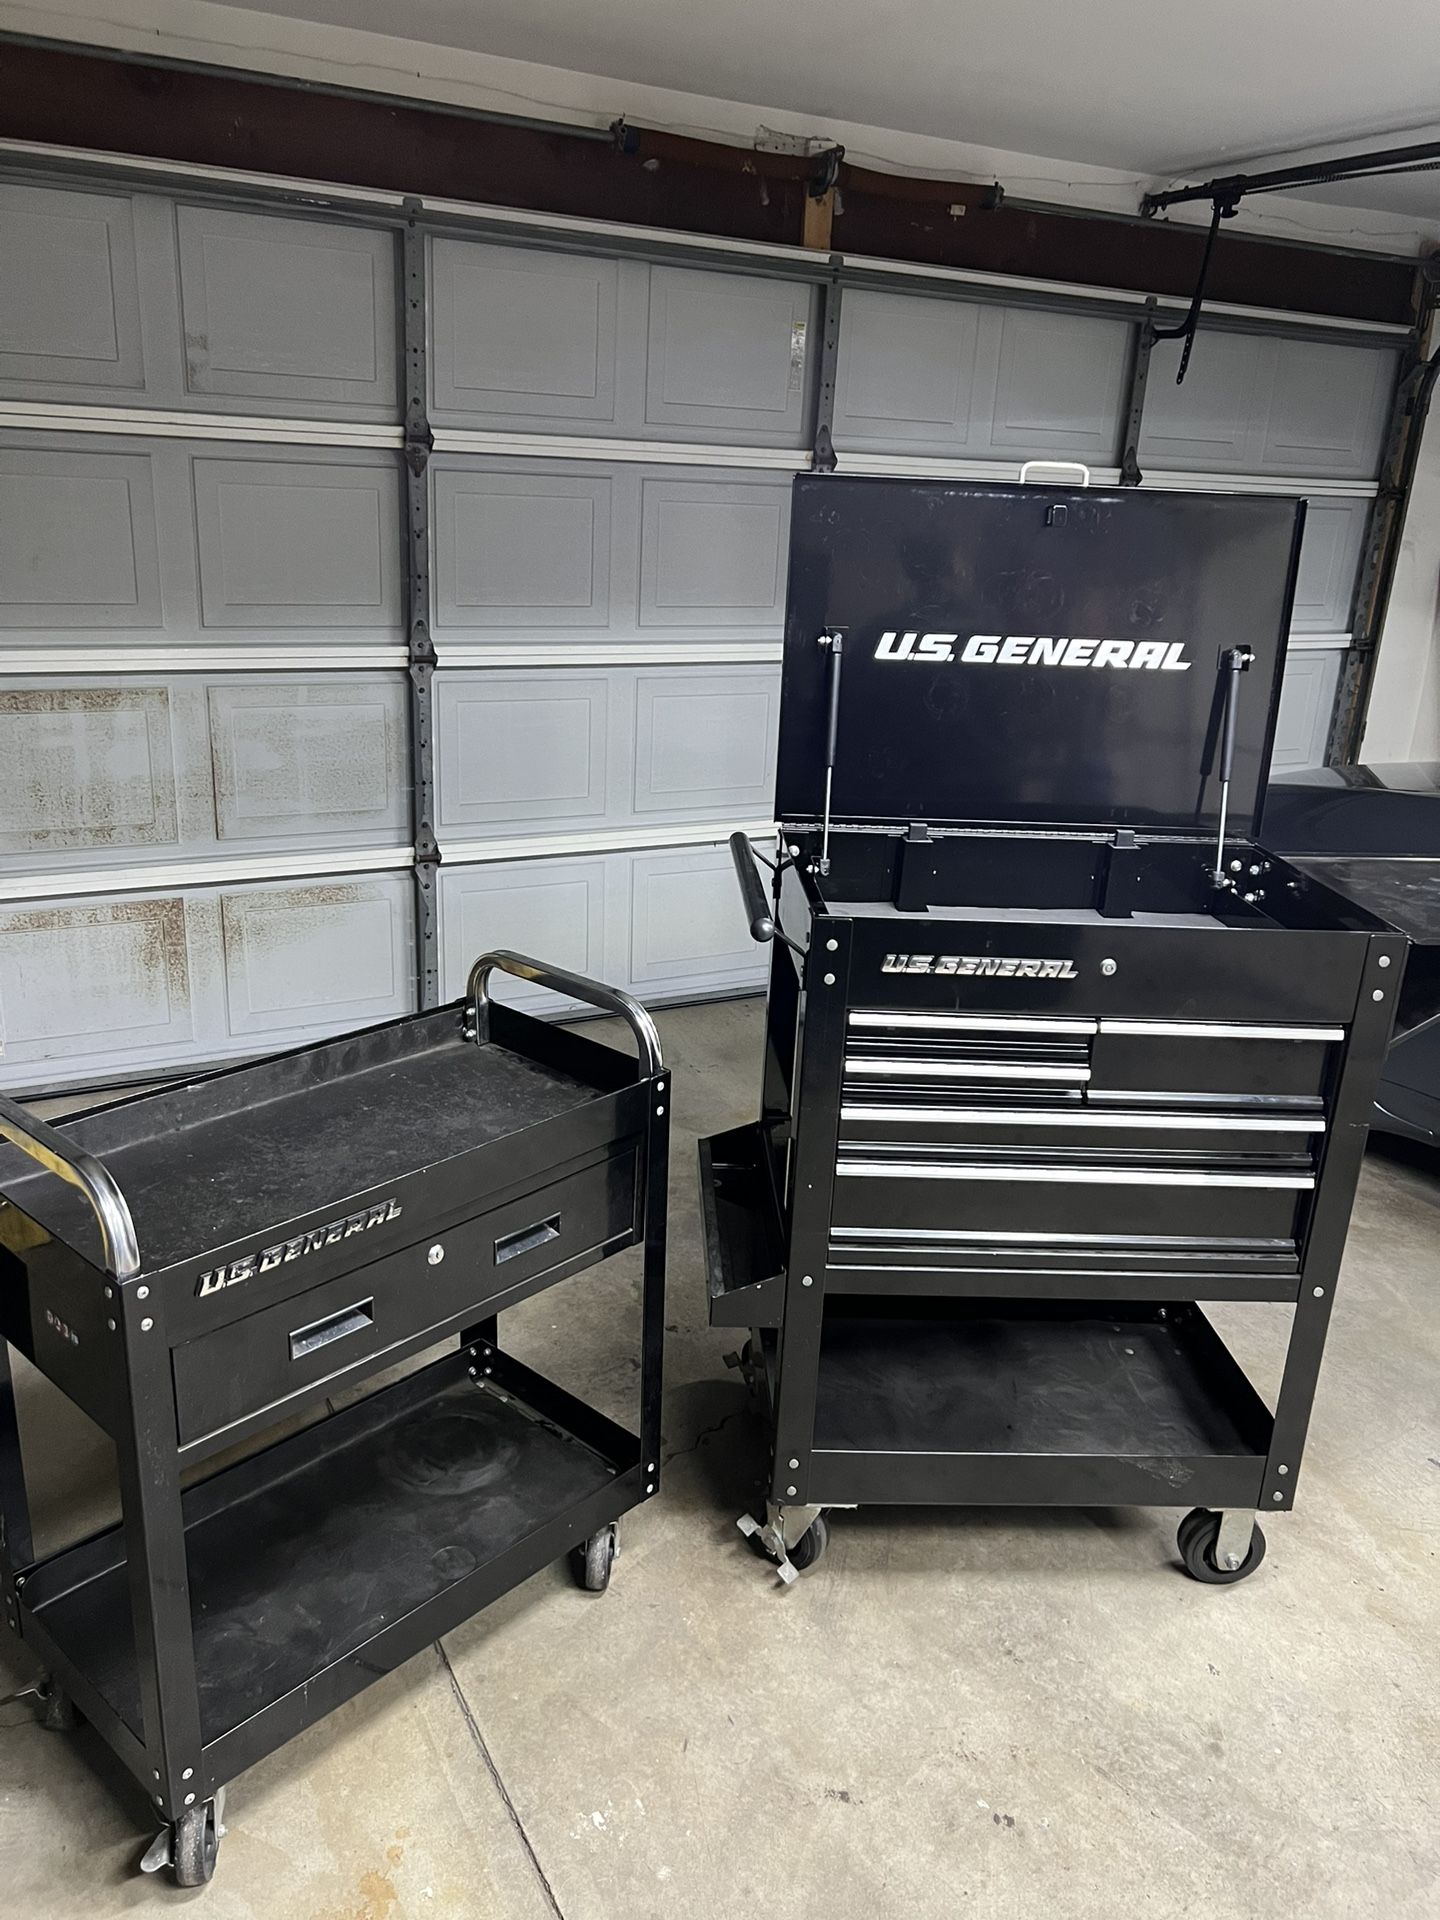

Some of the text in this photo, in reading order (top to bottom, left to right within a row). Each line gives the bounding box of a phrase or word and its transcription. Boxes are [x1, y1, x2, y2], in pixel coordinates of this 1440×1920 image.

[874, 632, 1192, 671] U.S. GENERAL
[882, 954, 1079, 979] U.S. GENERAL
[197, 1197, 402, 1297] U.S. GENERAL
